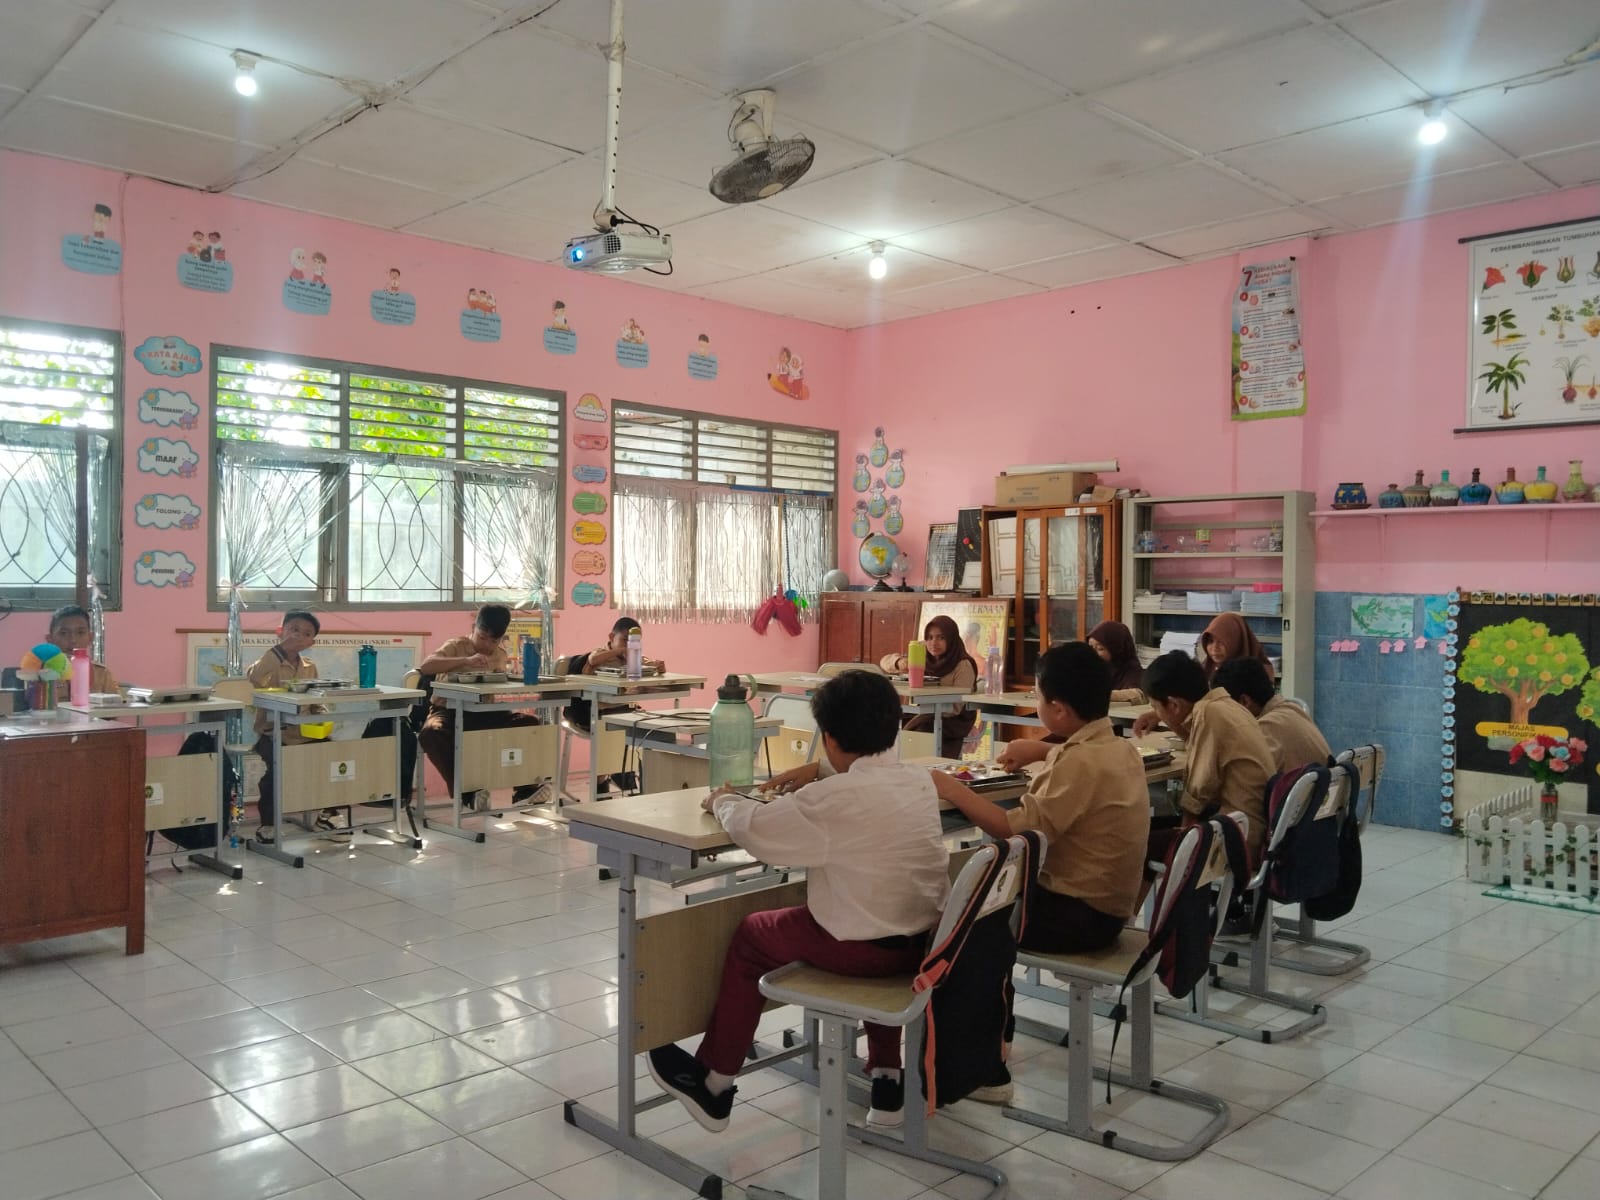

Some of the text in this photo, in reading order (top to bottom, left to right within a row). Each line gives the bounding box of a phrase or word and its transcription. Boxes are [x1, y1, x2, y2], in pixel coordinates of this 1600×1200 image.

[155, 455, 177, 464] MAAF
[1508, 724, 1536, 732] MAJAS
[1491, 729, 1537, 738] PERSONIFIK
